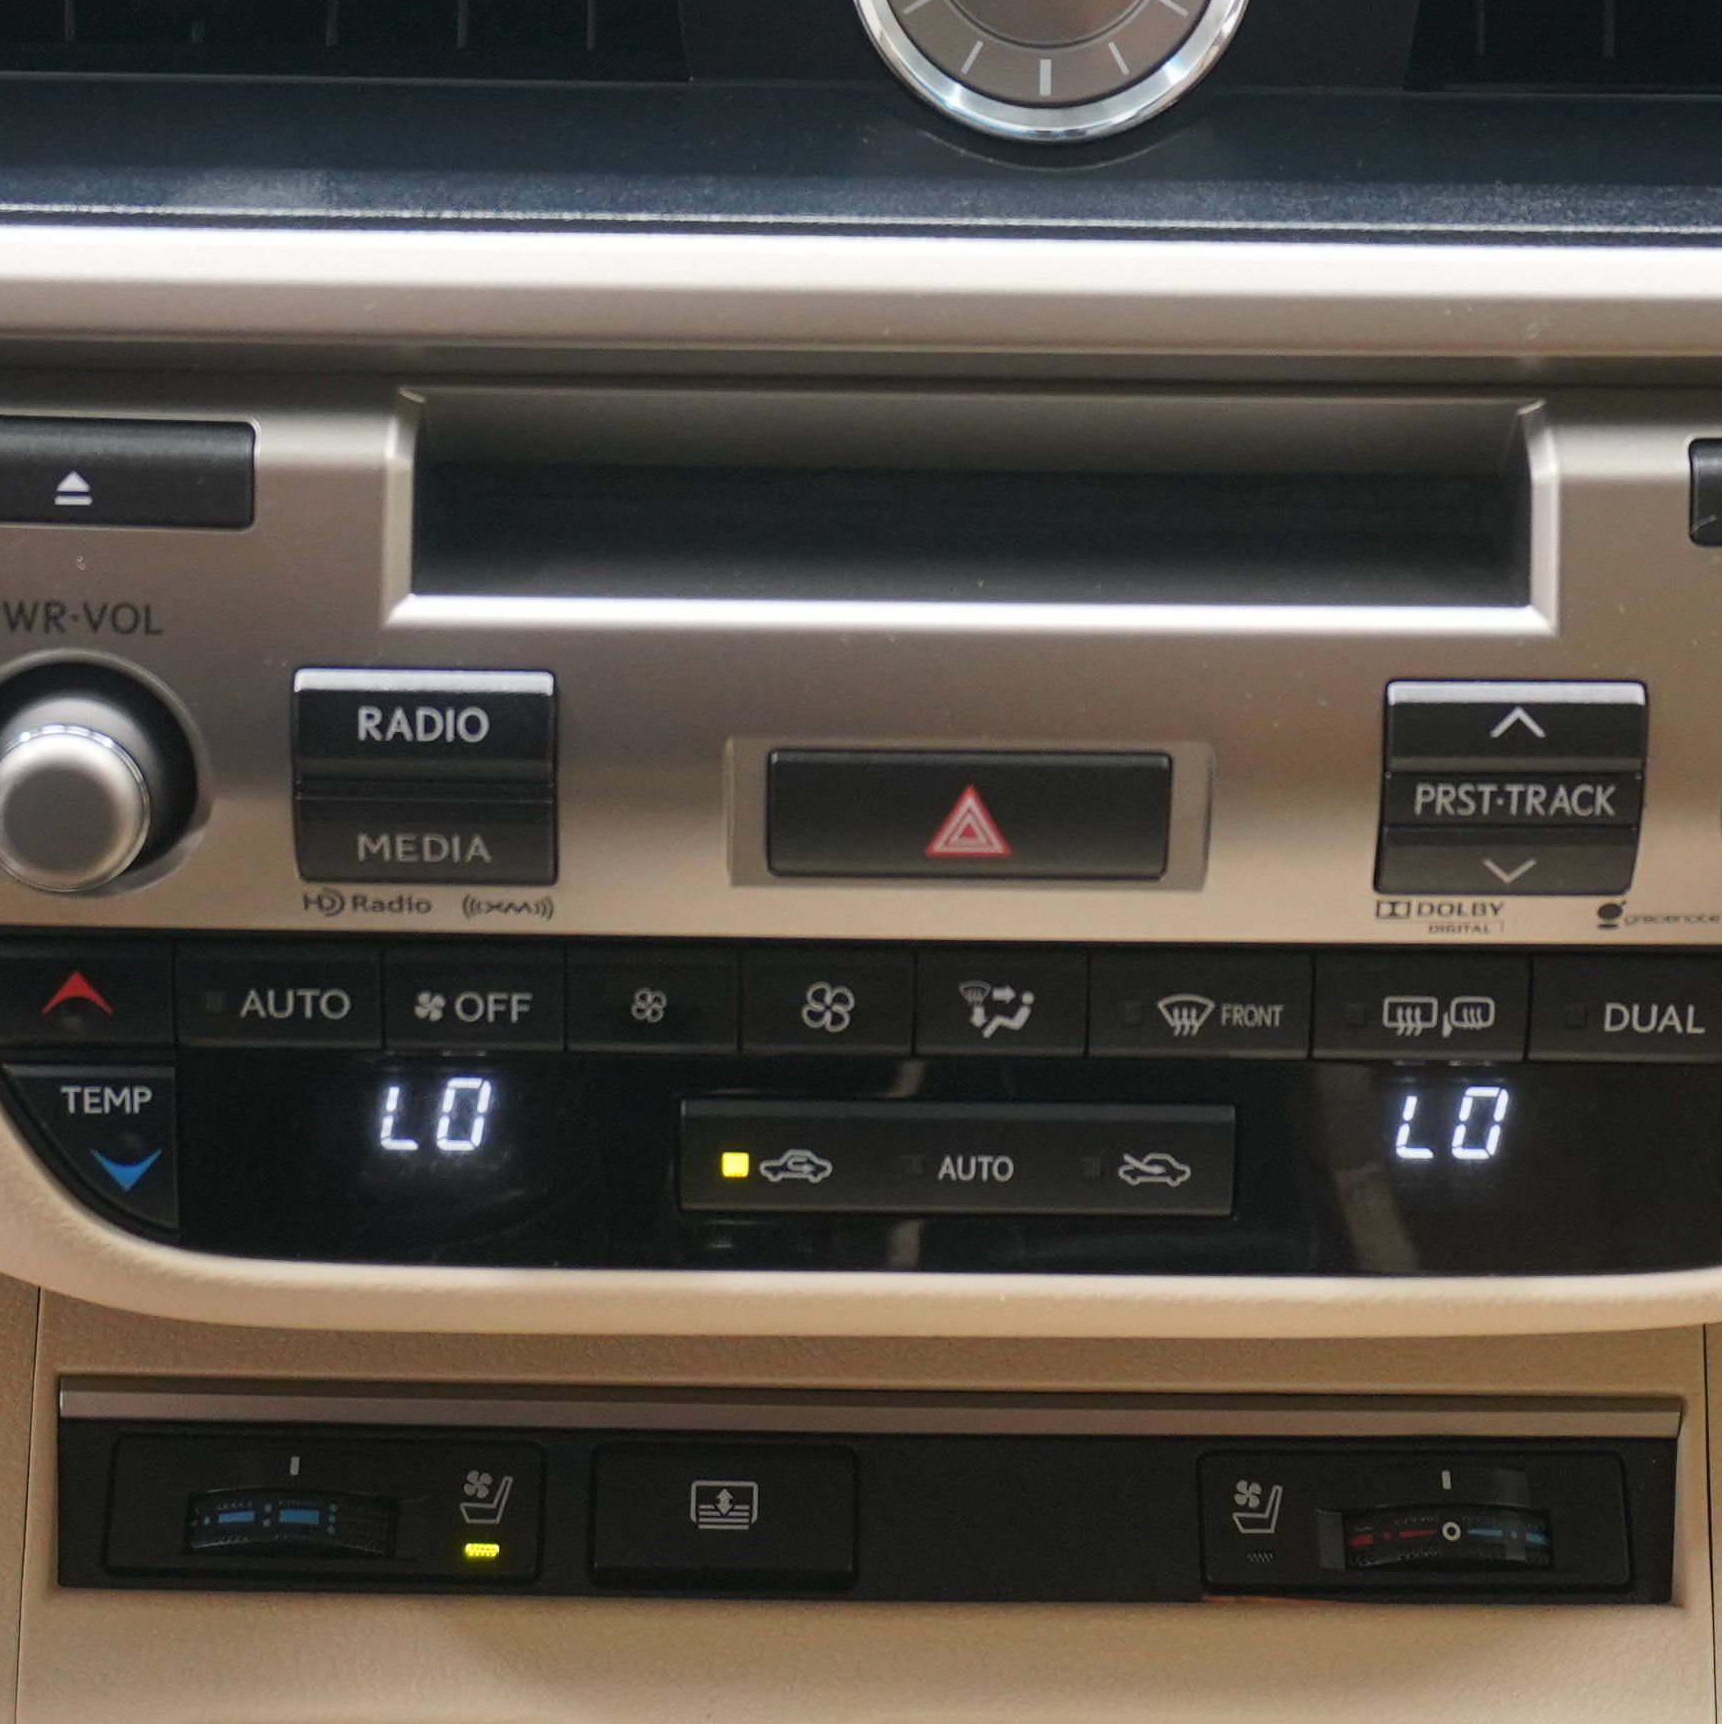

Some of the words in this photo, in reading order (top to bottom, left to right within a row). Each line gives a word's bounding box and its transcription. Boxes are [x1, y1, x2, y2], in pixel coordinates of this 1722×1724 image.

[357, 705, 490, 745] RADIO
[357, 833, 493, 865] MEDIA
[351, 894, 432, 915] Radio
[1416, 900, 1505, 917] DOLBY
[1428, 924, 1492, 936] DIGITAL
[240, 989, 351, 1020] AUTO
[454, 991, 533, 1023] OFF
[1220, 1003, 1284, 1029] FRONT
[1603, 1003, 1706, 1036] DUAL
[61, 1086, 153, 1116] TEMP
[938, 1155, 1014, 1182] AUTO
